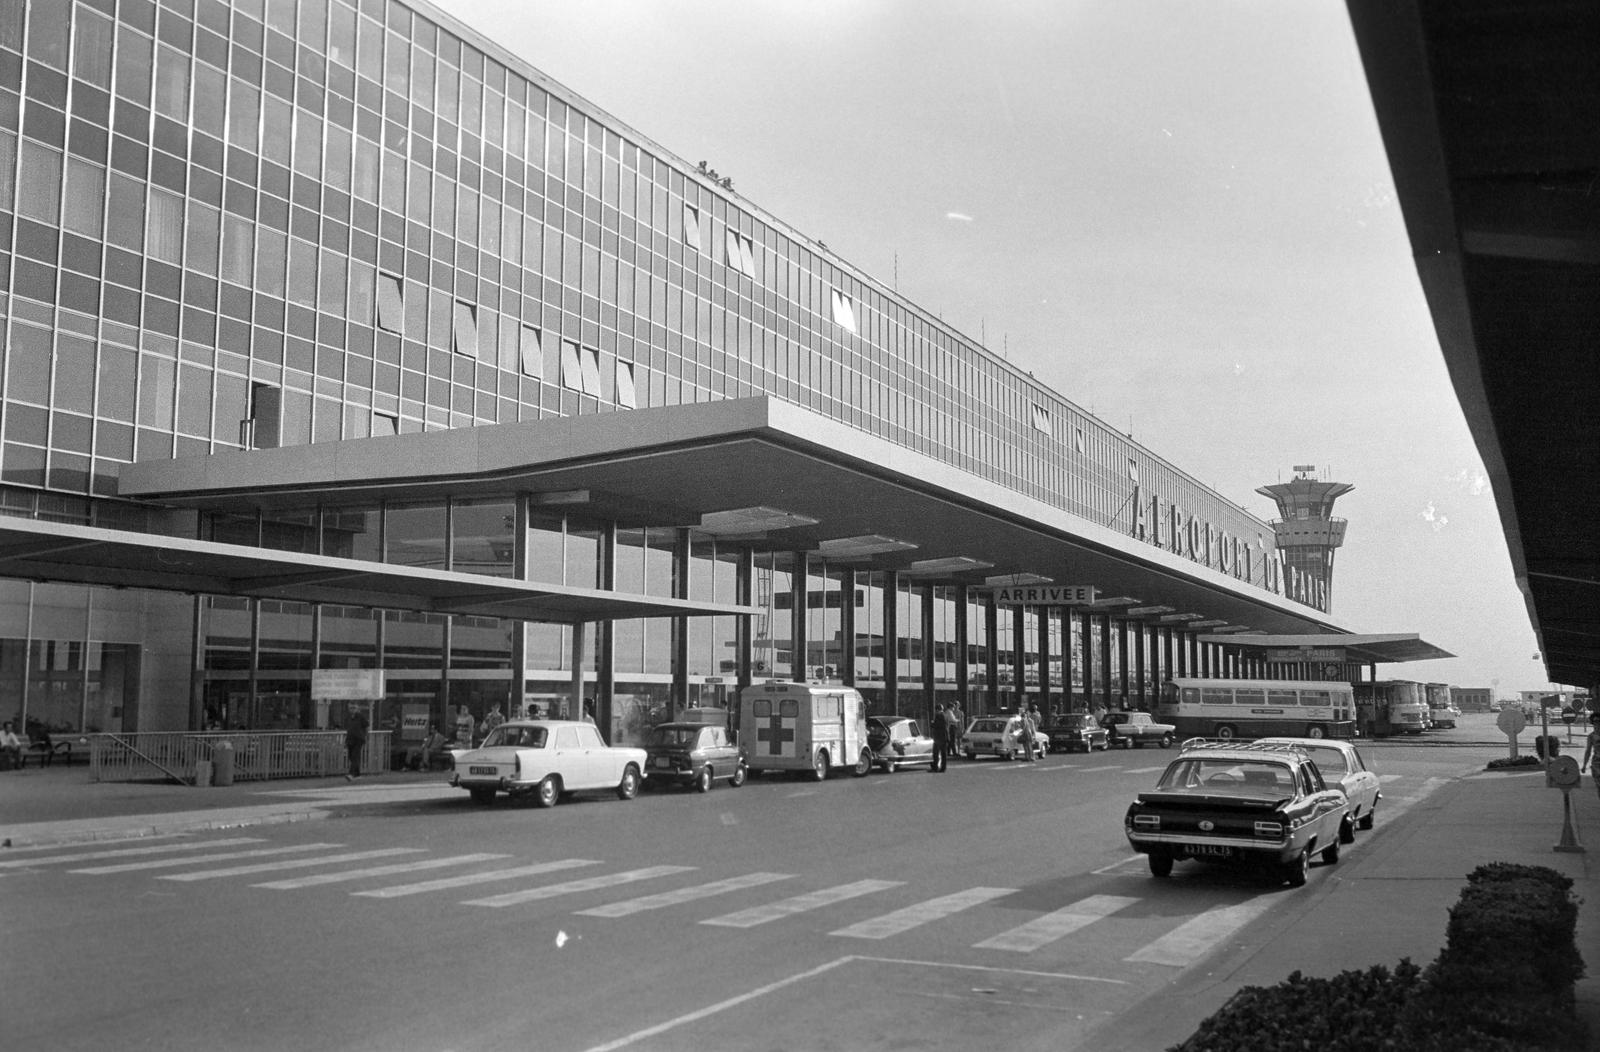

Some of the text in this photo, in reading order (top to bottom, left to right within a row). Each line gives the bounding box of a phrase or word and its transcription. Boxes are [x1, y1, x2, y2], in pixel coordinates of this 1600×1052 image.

[1132, 486, 1254, 584] AEROPORT
[1291, 566, 1326, 613] PARIS
[1000, 588, 1086, 600] ARRIVEE
